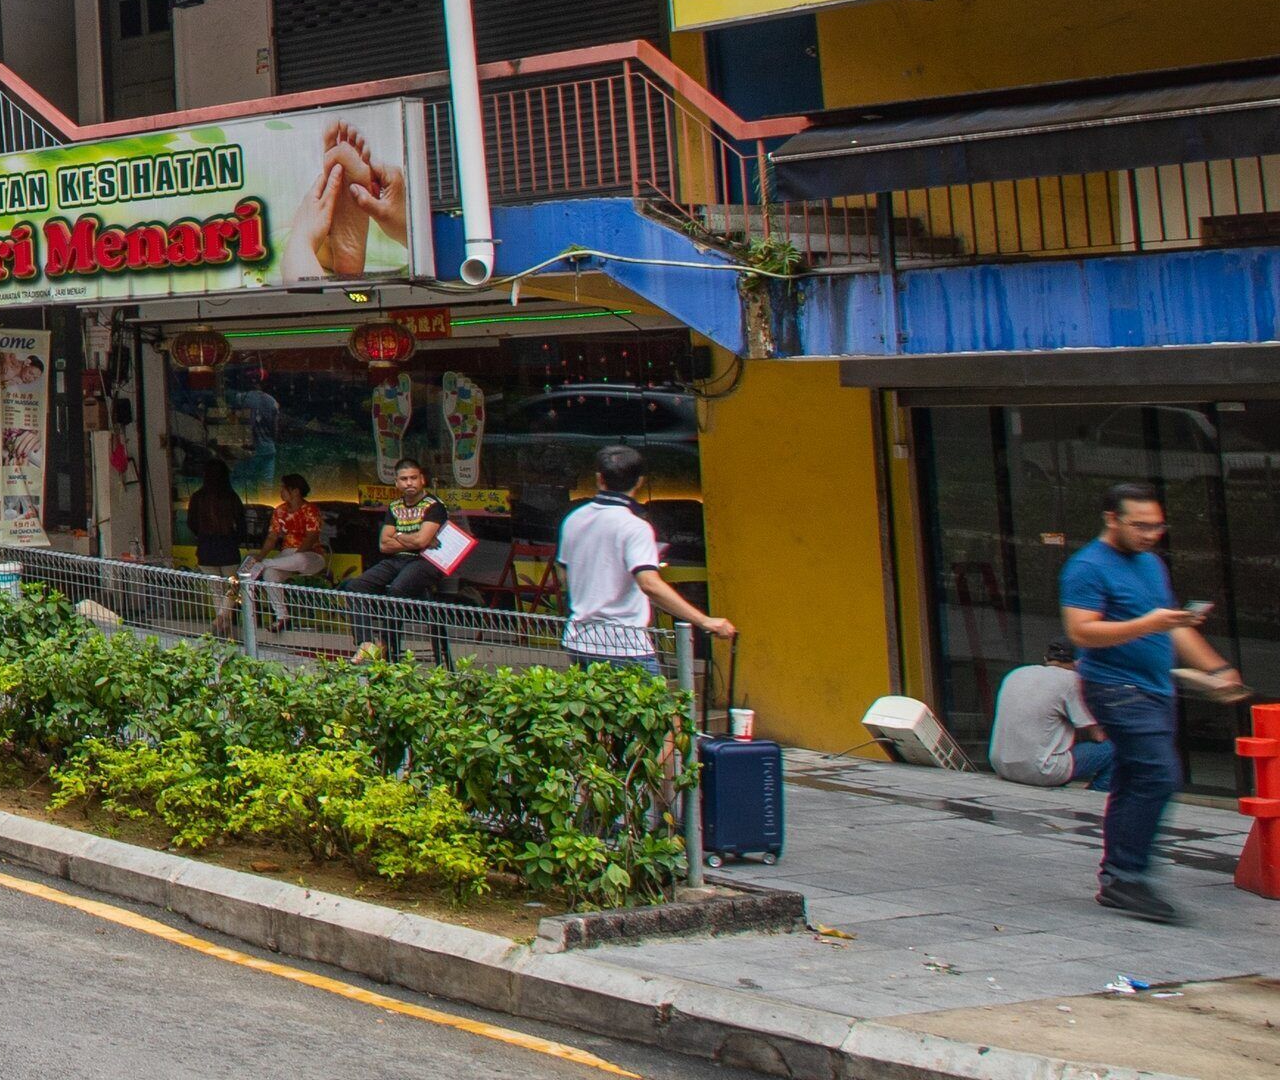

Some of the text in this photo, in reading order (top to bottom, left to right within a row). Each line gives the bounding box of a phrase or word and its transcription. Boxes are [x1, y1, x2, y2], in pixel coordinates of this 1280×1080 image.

[57, 144, 244, 208] KESIHATAN
[42, 201, 265, 277] Menari
[21, 287, 53, 299] TRADISIONA
